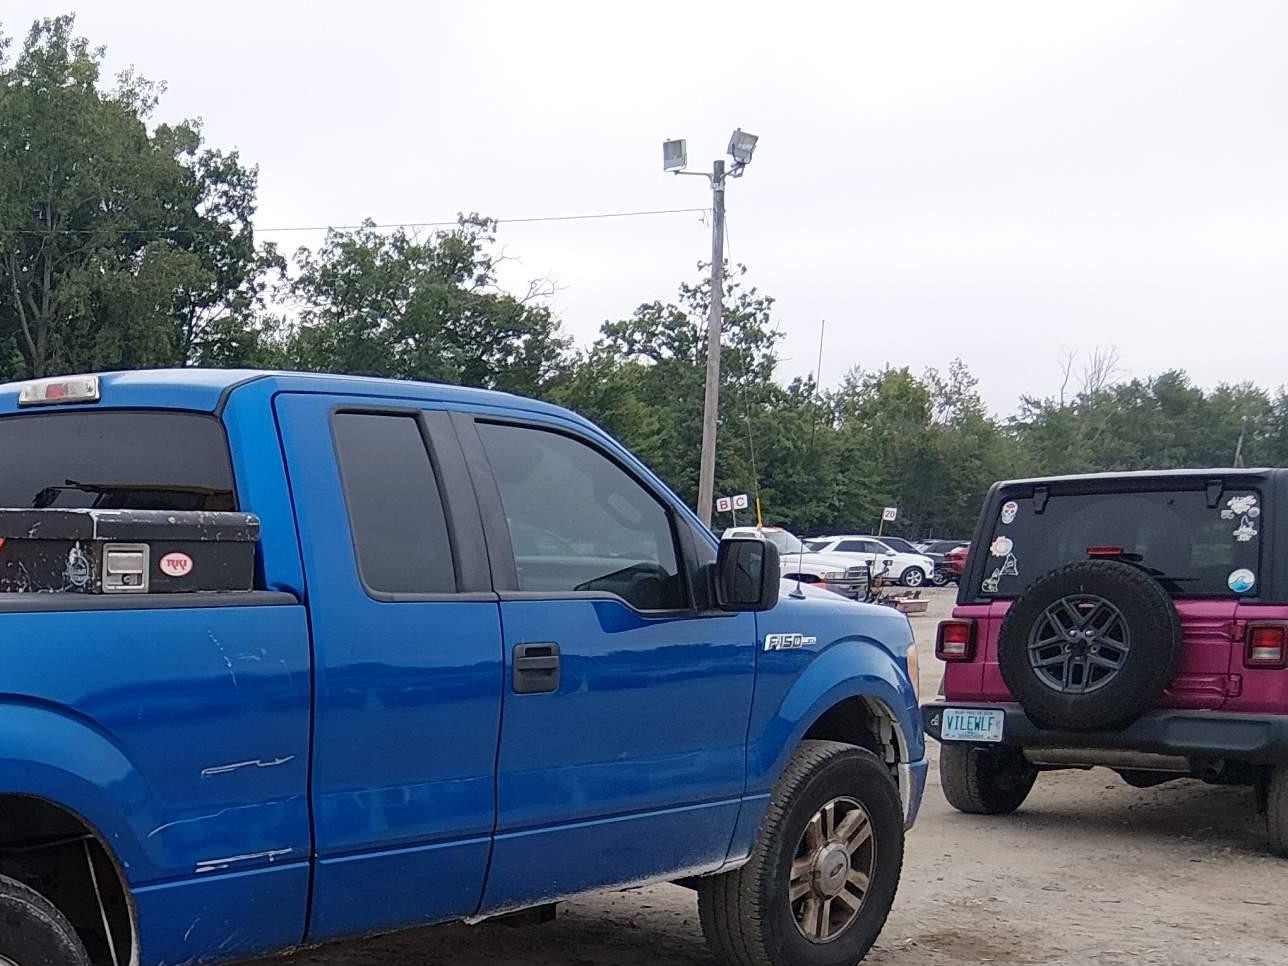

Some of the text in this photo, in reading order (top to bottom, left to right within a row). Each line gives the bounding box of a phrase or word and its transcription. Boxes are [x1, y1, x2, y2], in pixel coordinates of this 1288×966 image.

[719, 500, 729, 510] B
[884, 510, 896, 519] 20
[946, 715, 996, 732] VILEWLF
